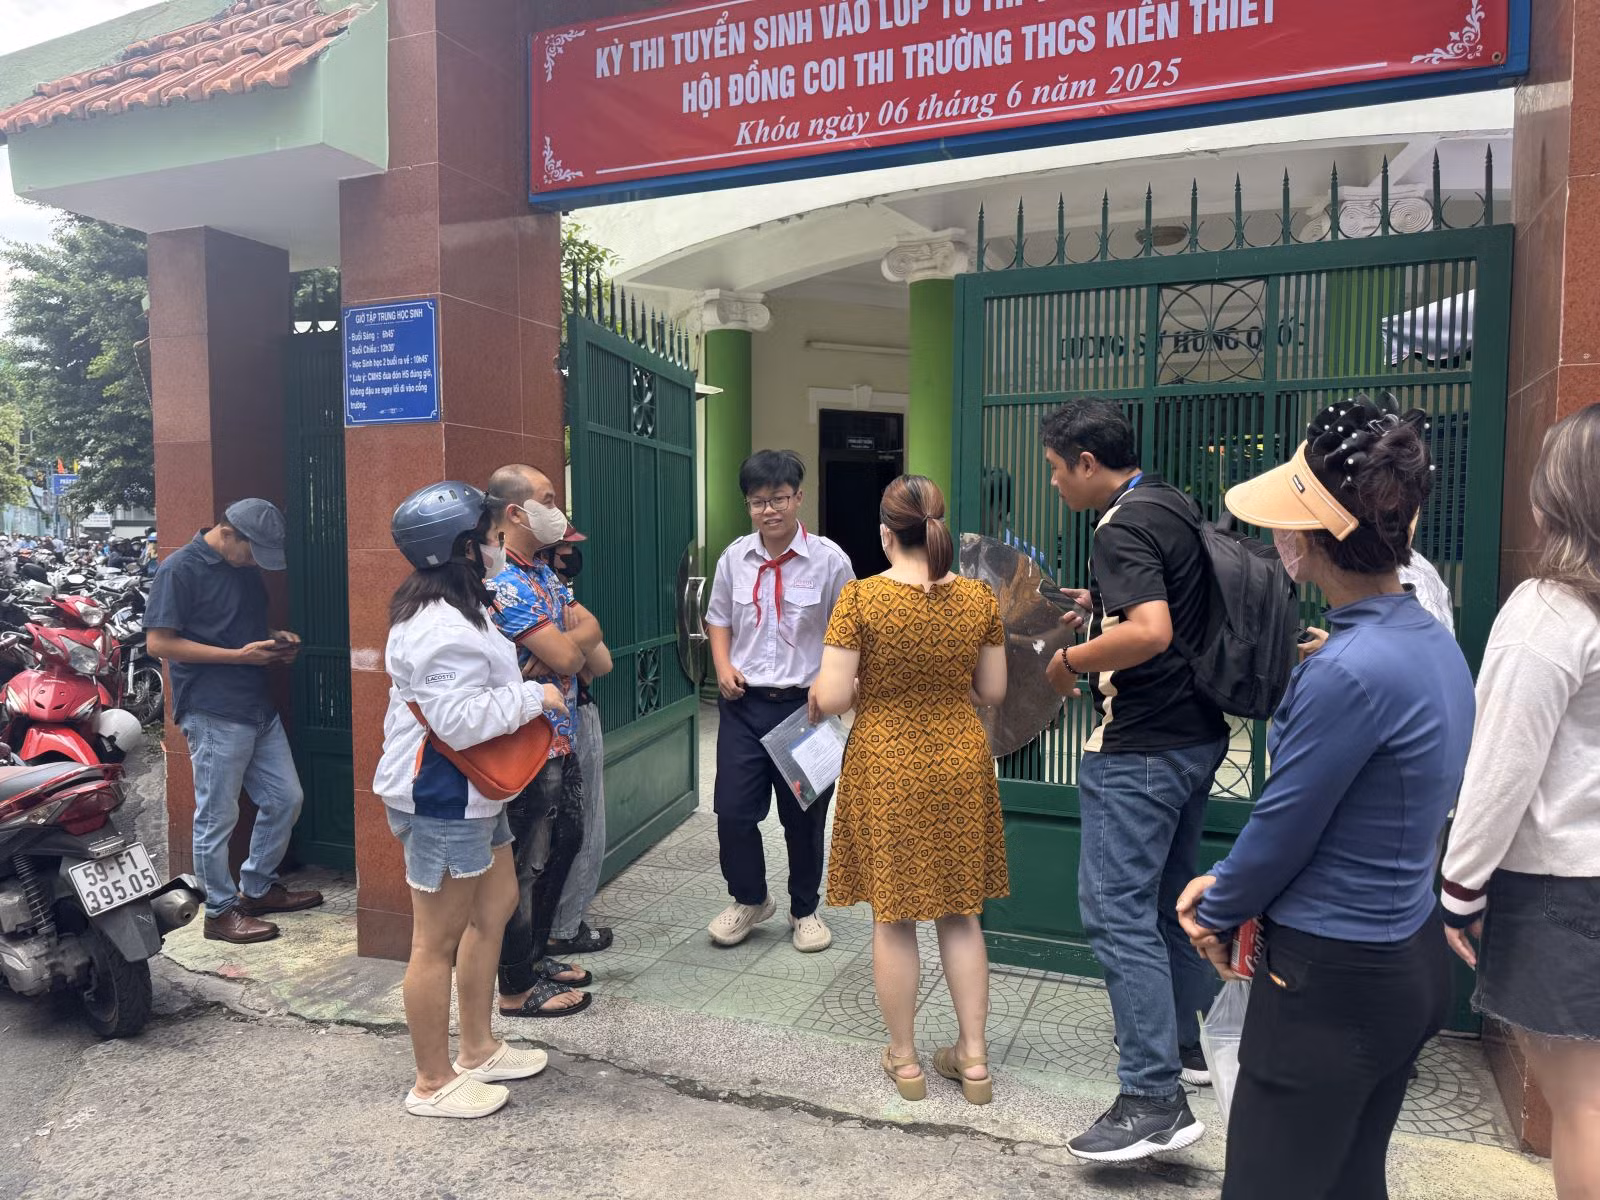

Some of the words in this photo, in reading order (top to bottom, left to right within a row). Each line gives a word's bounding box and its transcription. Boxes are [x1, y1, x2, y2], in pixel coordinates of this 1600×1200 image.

[596, 38, 624, 79] KỲ
[630, 36, 665, 73] THI
[671, 10, 746, 65] TUYỂN
[753, 8, 813, 51] SINH
[682, 71, 721, 118] HỘI
[728, 59, 795, 107] ĐỒNG
[803, 56, 845, 95] COI
[853, 48, 894, 87] THI
[902, 28, 1012, 80] TRƯỜNG
[1021, 15, 1096, 61] THCS
[735, 116, 800, 147] Khóa
[808, 106, 870, 141] ngày
[877, 97, 910, 127] 06
[917, 90, 997, 120] tháng
[1006, 80, 1024, 109] 6
[1031, 74, 1096, 105] năm
[1105, 57, 1183, 95] 2025
[378, 311, 396, 322] TRUNG
[409, 308, 424, 319] SINH
[427, 674, 454, 682] LACOSTE
[82, 850, 138, 887] 59-F1
[85, 867, 156, 912] 395.05
